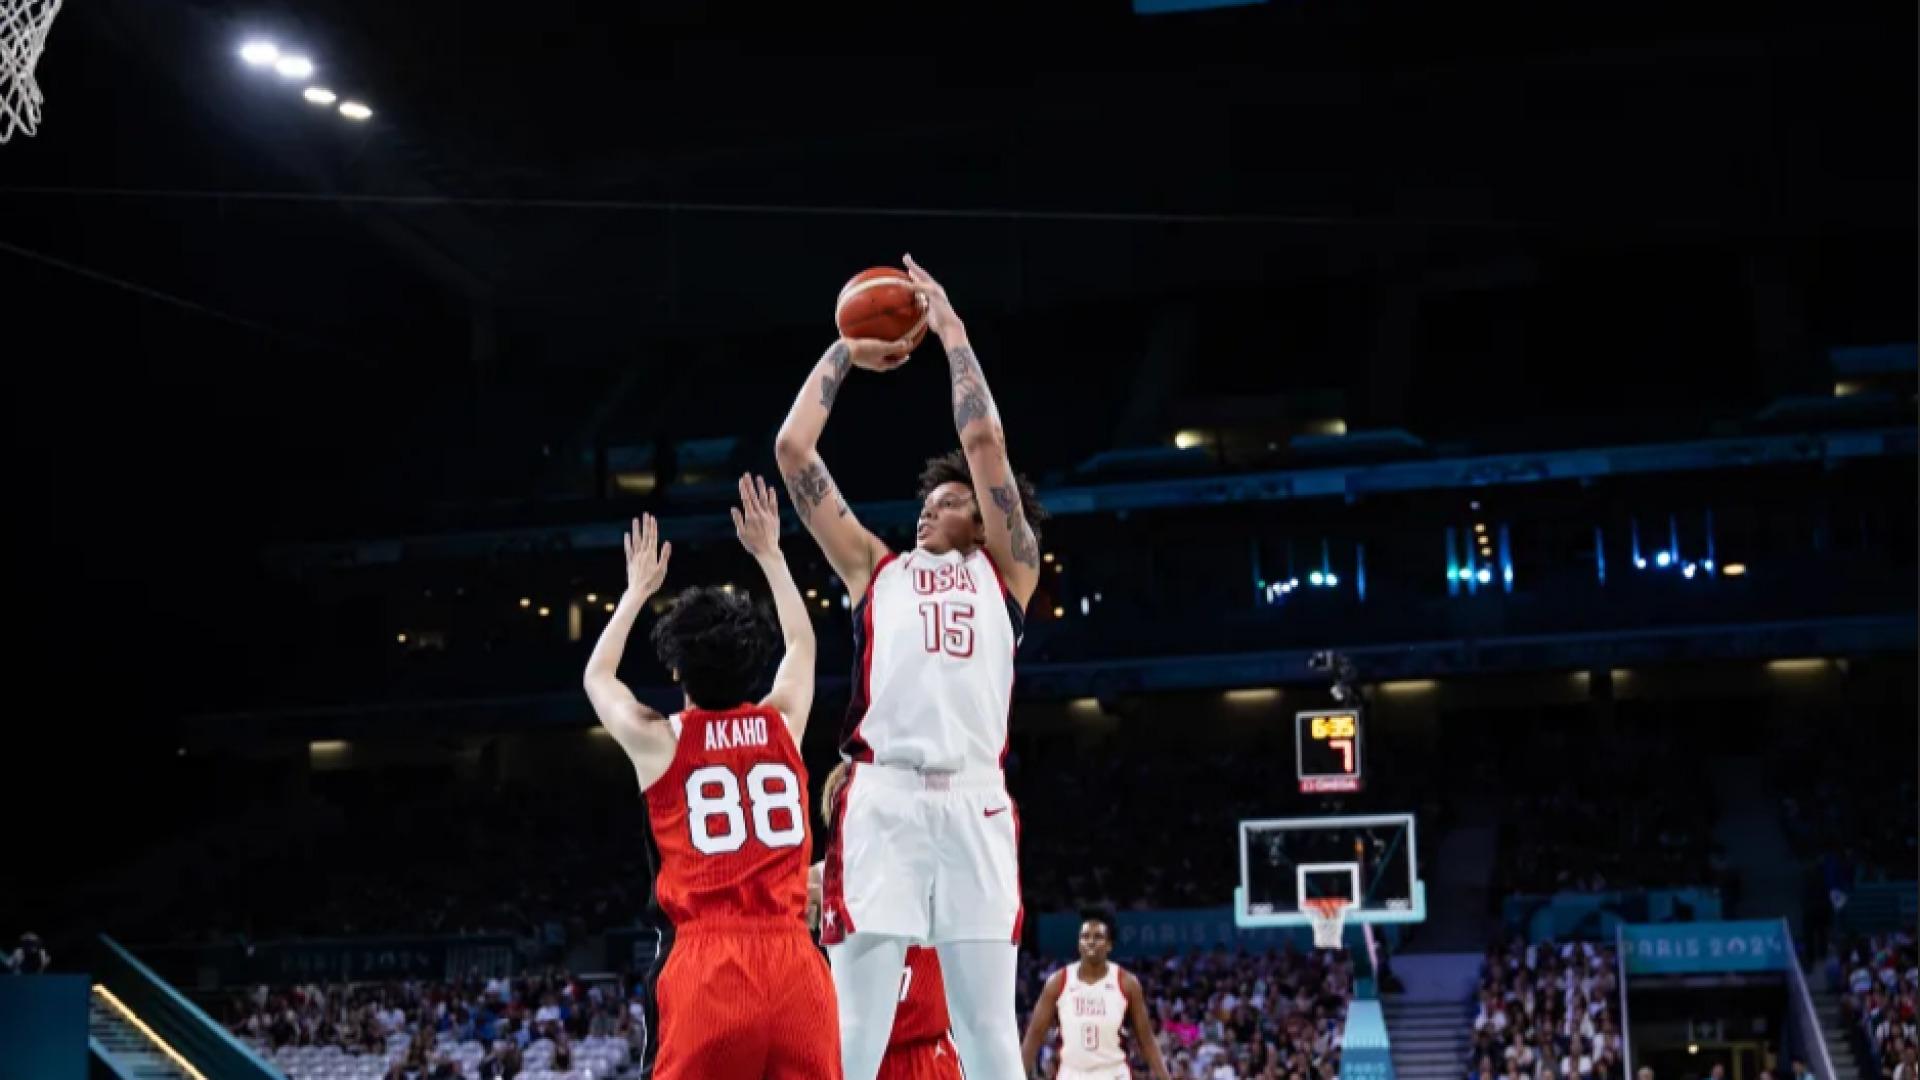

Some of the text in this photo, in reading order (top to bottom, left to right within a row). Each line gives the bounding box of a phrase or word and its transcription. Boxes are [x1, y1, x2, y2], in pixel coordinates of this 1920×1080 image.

[912, 562, 977, 595] USA
[919, 601, 975, 658] 15
[705, 716, 768, 750] AKAHO
[1328, 739, 1354, 772] 7
[685, 763, 805, 855] 88
